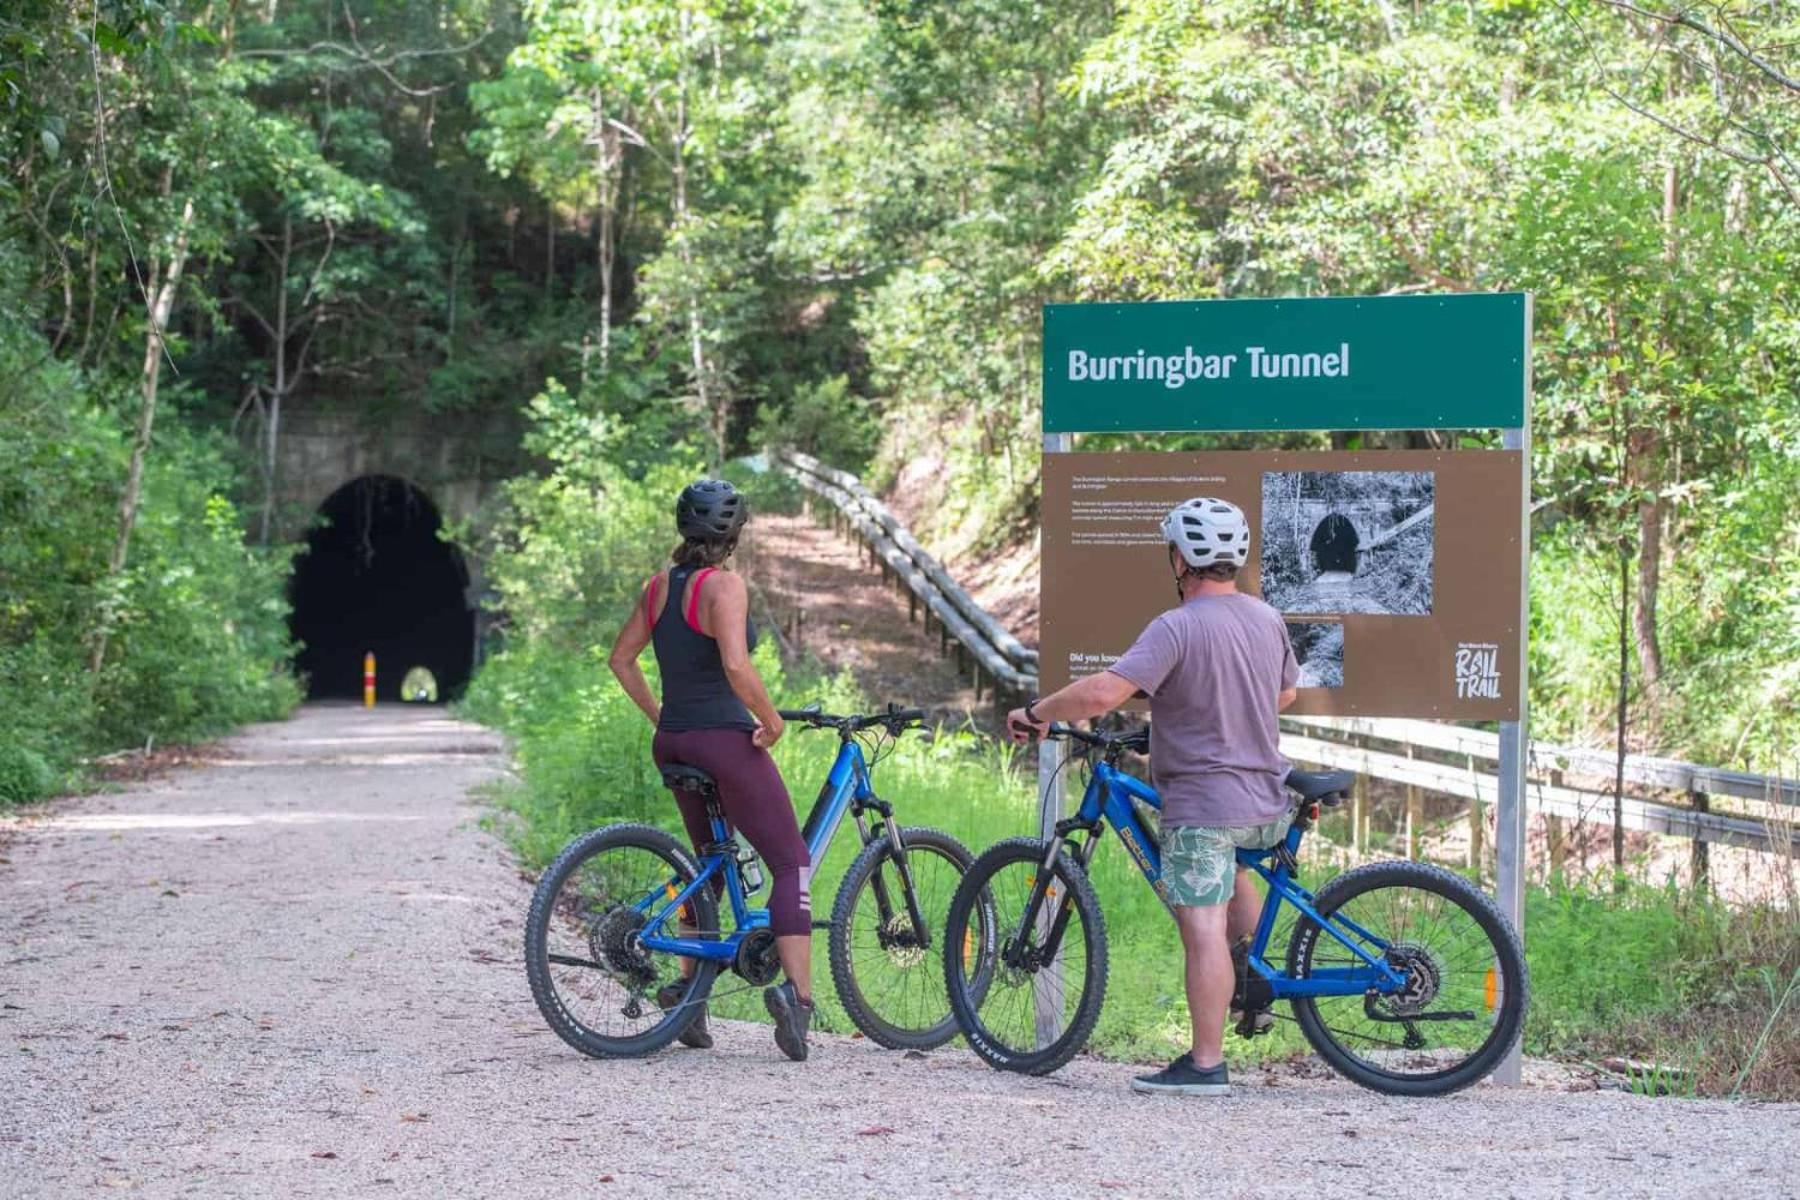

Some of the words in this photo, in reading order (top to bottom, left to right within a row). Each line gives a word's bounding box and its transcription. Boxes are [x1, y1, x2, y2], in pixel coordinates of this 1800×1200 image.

[1068, 346, 1236, 389] Burringbar
[1246, 343, 1349, 378] Tunnel
[1070, 653, 1083, 662] Did
[1085, 655, 1099, 664] you
[1455, 649, 1501, 677] RAIL
[1455, 675, 1501, 698] TRAIL
